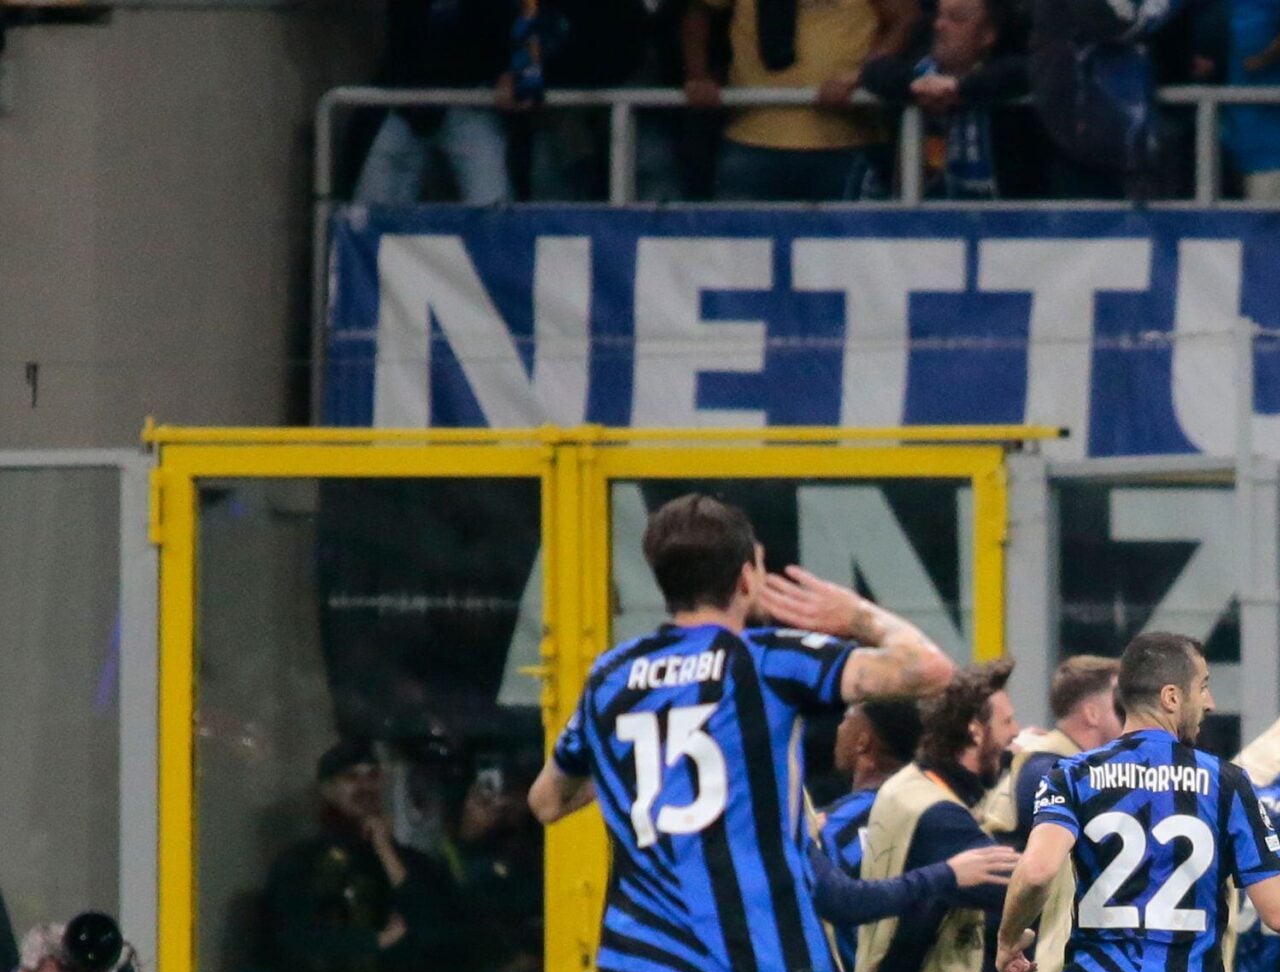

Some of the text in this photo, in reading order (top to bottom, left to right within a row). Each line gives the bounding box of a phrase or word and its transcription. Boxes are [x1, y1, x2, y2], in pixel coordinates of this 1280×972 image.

[626, 648, 727, 691] ACERBI
[616, 702, 729, 849] 15
[1088, 762, 1210, 796] MKHITARYAN
[1077, 811, 1216, 933] 22
